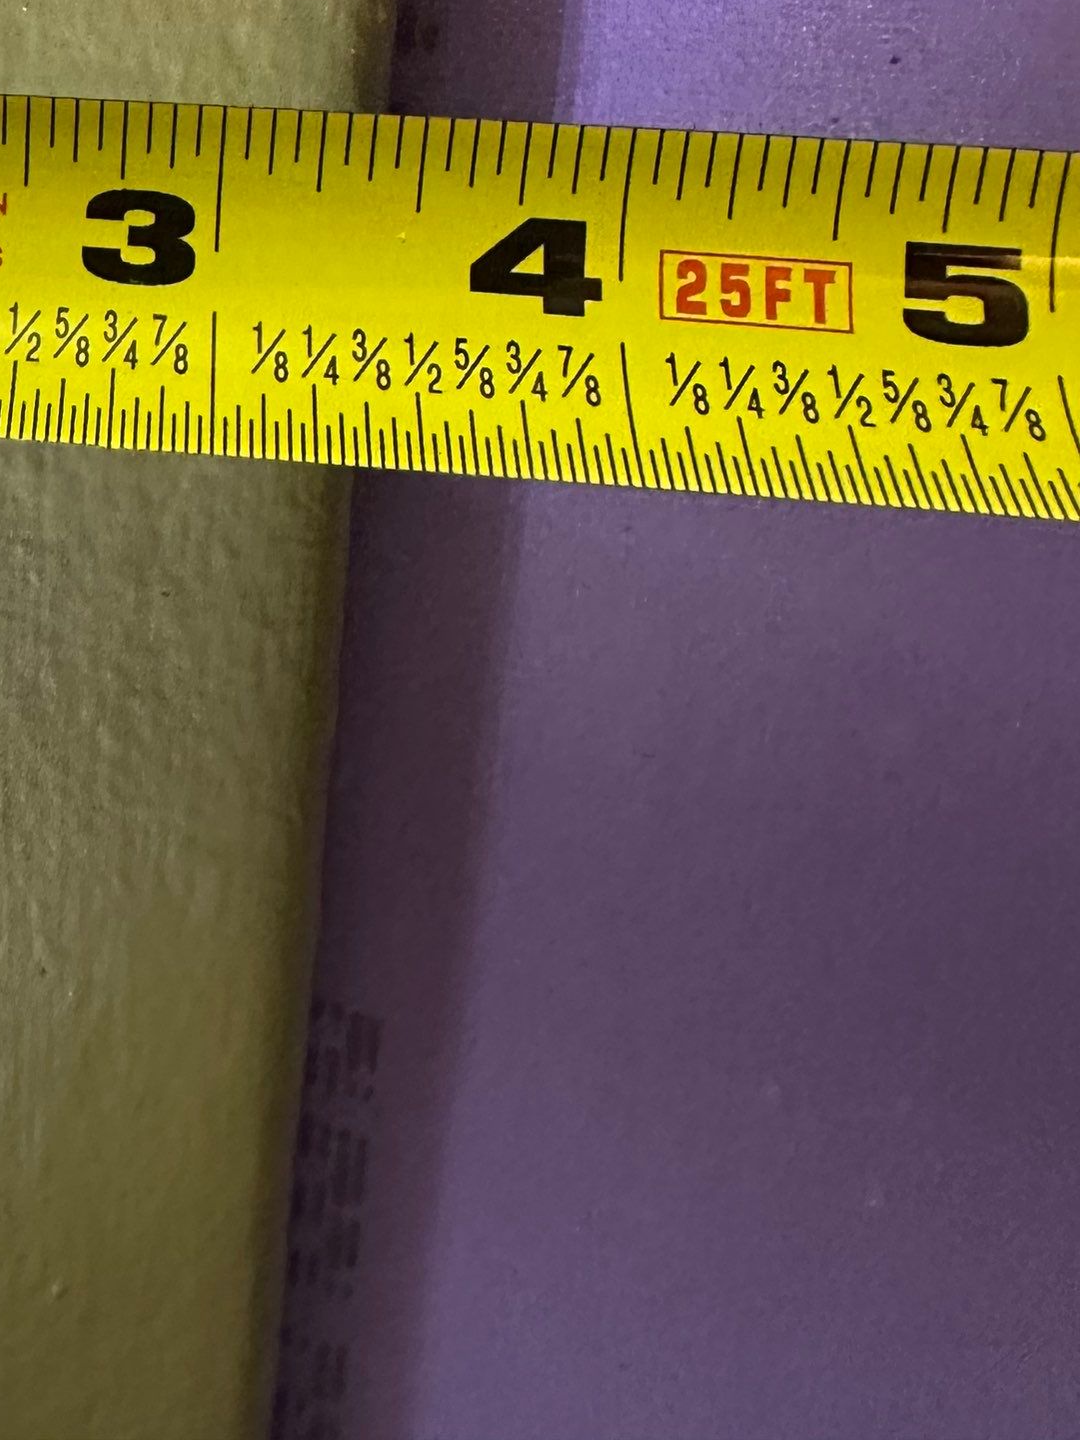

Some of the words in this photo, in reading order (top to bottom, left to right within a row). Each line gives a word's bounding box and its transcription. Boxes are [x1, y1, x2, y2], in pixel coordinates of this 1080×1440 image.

[82, 189, 196, 285] 3
[470, 217, 603, 317] 4
[676, 259, 836, 325] 25FT
[903, 241, 1029, 346] 5
[5, 302, 41, 362] 1/2
[53, 306, 89, 367] 5/8
[102, 310, 138, 370] 3/4
[151, 313, 188, 375] 7/8
[252, 322, 289, 382] 1/8
[302, 325, 339, 385] 1/4
[351, 329, 391, 389] 3/8
[404, 332, 443, 393] 1/2
[454, 338, 495, 399] 5/8
[505, 340, 546, 402] 3/4
[558, 345, 601, 407] 7/8
[666, 352, 709, 415] 1/8
[719, 357, 763, 419] 1/4
[772, 360, 819, 423] 3/8
[827, 368, 875, 427] 1/2
[881, 369, 932, 432] 5/8
[938, 374, 989, 436] 3/4
[991, 378, 1045, 441] 7/8
